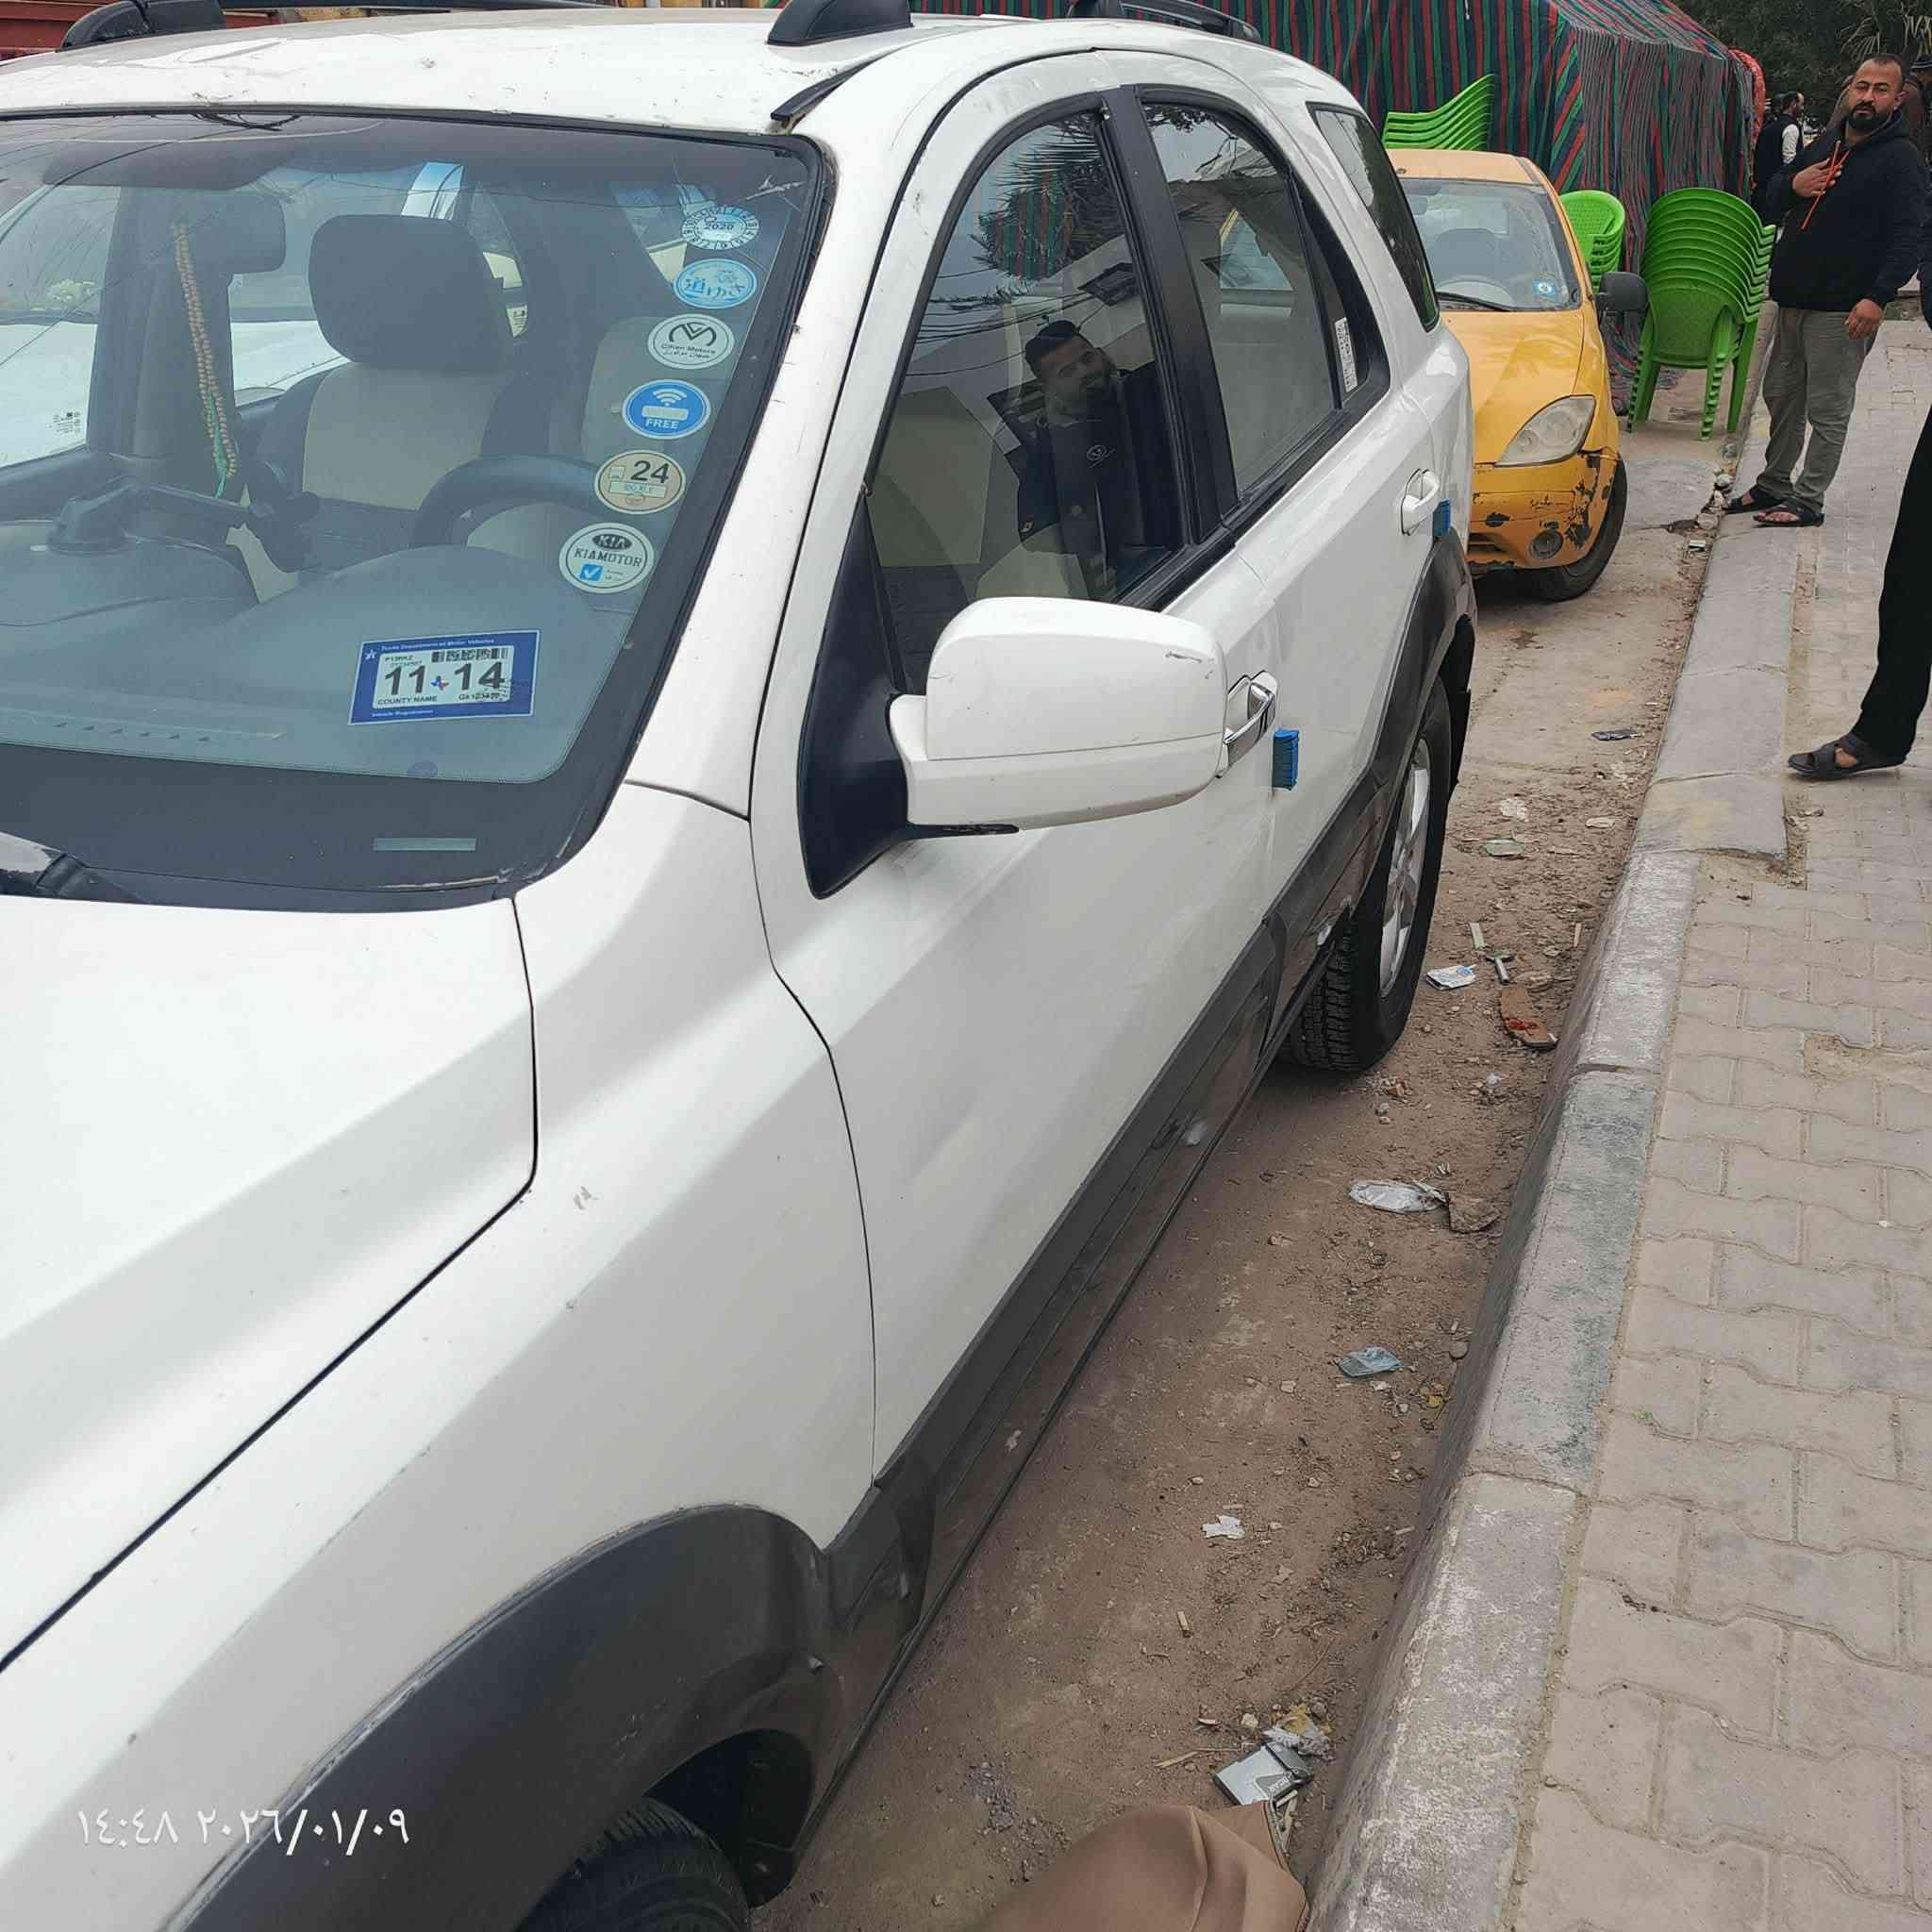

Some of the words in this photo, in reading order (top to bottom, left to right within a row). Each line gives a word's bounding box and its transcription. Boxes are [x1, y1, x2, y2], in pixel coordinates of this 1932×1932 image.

[645, 419, 679, 430] FREE
[630, 460, 670, 484] 24
[598, 535, 627, 549] KIA
[574, 547, 643, 568] KIAMOTOR
[385, 665, 425, 696] 11
[455, 661, 506, 691] 14
[377, 696, 412, 706] COUNTY
[413, 694, 438, 704] NAME
